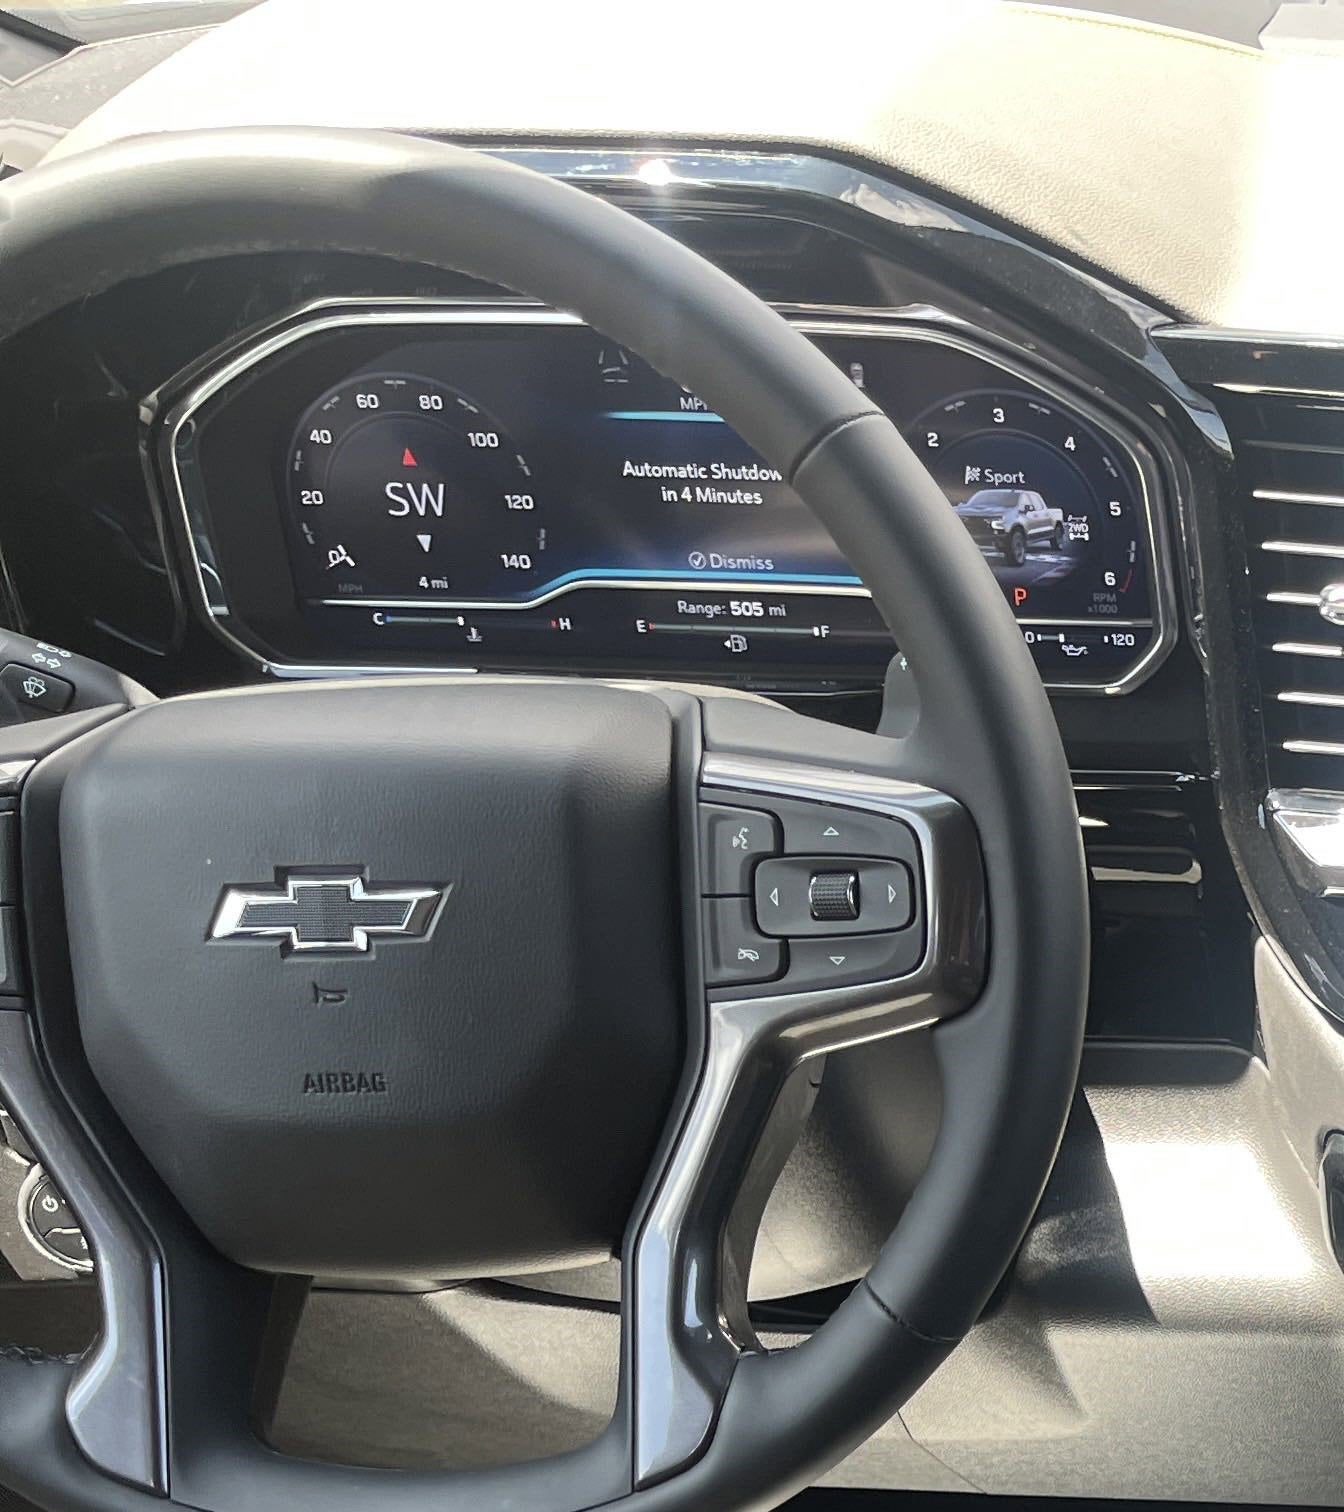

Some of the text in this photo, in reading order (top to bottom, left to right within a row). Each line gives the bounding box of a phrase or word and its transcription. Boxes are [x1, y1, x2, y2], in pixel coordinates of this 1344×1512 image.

[355, 393, 380, 409] 60
[418, 394, 443, 411] 80
[992, 407, 1005, 423] 3
[309, 428, 332, 445] 40
[467, 432, 499, 448] 100
[927, 432, 939, 448] 2
[1064, 436, 1076, 451] 4
[622, 460, 783, 482] Automatic Shutdow
[984, 468, 1026, 487] Sport
[300, 490, 324, 506] 20
[385, 481, 445, 517] SW
[504, 494, 535, 510] 120
[661, 486, 763, 505] in 4 Minutes
[1109, 501, 1122, 517] 5
[500, 553, 531, 569] 140
[709, 553, 774, 571] Dismiss
[418, 576, 449, 589] 4 mi
[1104, 572, 1116, 587] 6
[1014, 588, 1027, 607] P
[677, 600, 786, 618] Range: 505 mi
[372, 612, 385, 625] C
[559, 617, 572, 632] H
[636, 619, 647, 633] E
[819, 624, 830, 639] F
[1110, 633, 1135, 647] 120
[303, 1071, 386, 1094] AIRBAG
